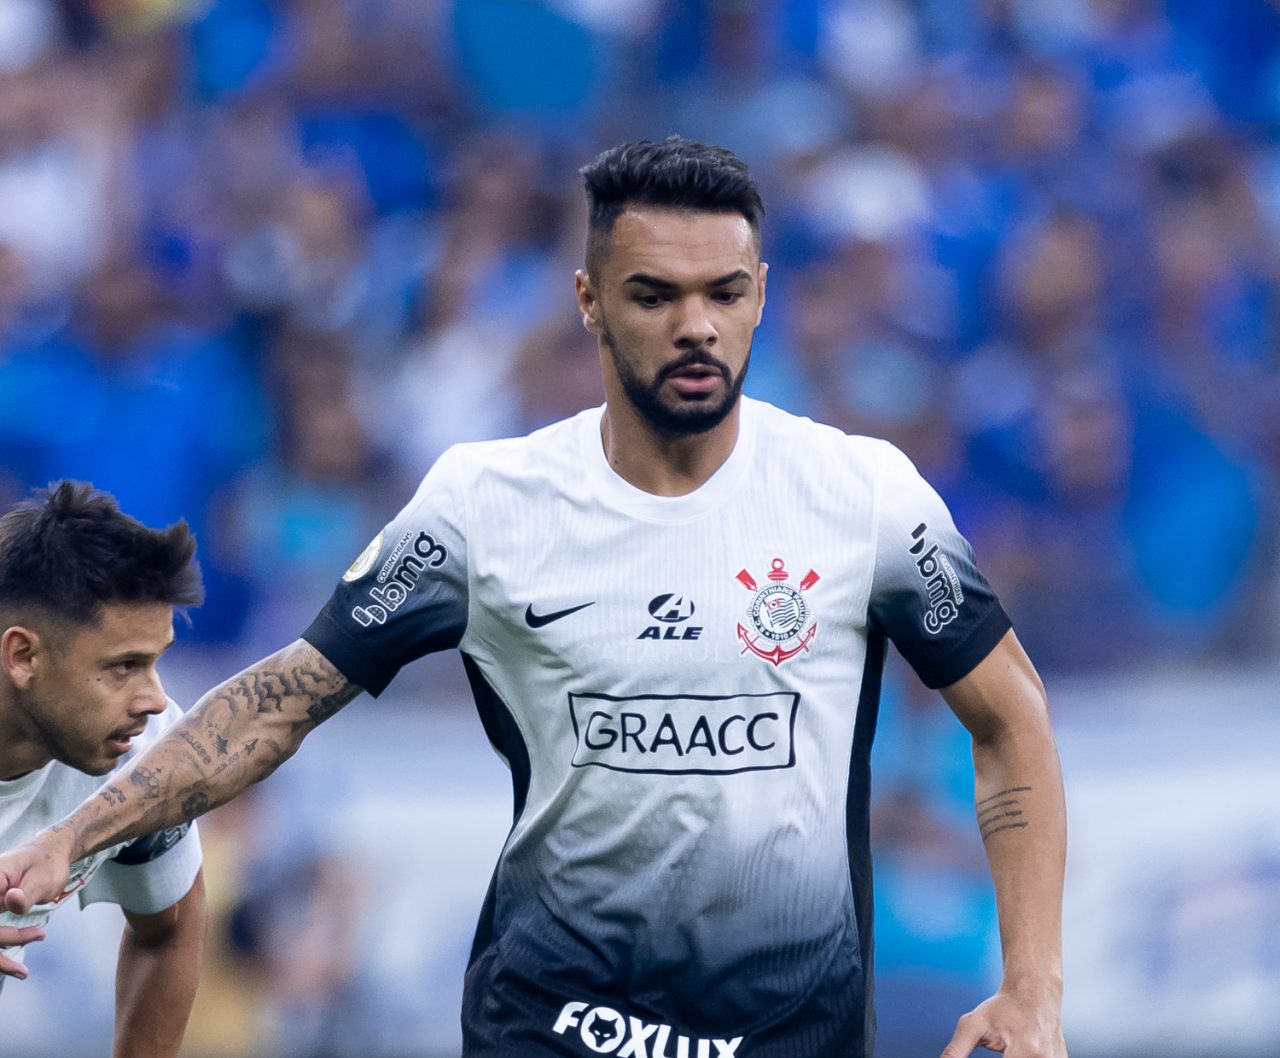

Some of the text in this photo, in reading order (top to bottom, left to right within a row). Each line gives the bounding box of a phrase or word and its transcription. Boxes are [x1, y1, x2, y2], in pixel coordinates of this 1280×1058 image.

[370, 529, 449, 612] bmg
[377, 529, 413, 584] CORINTHIANS
[915, 541, 958, 635] bmg
[637, 626, 703, 641] ALE
[584, 710, 779, 757] GRAACC
